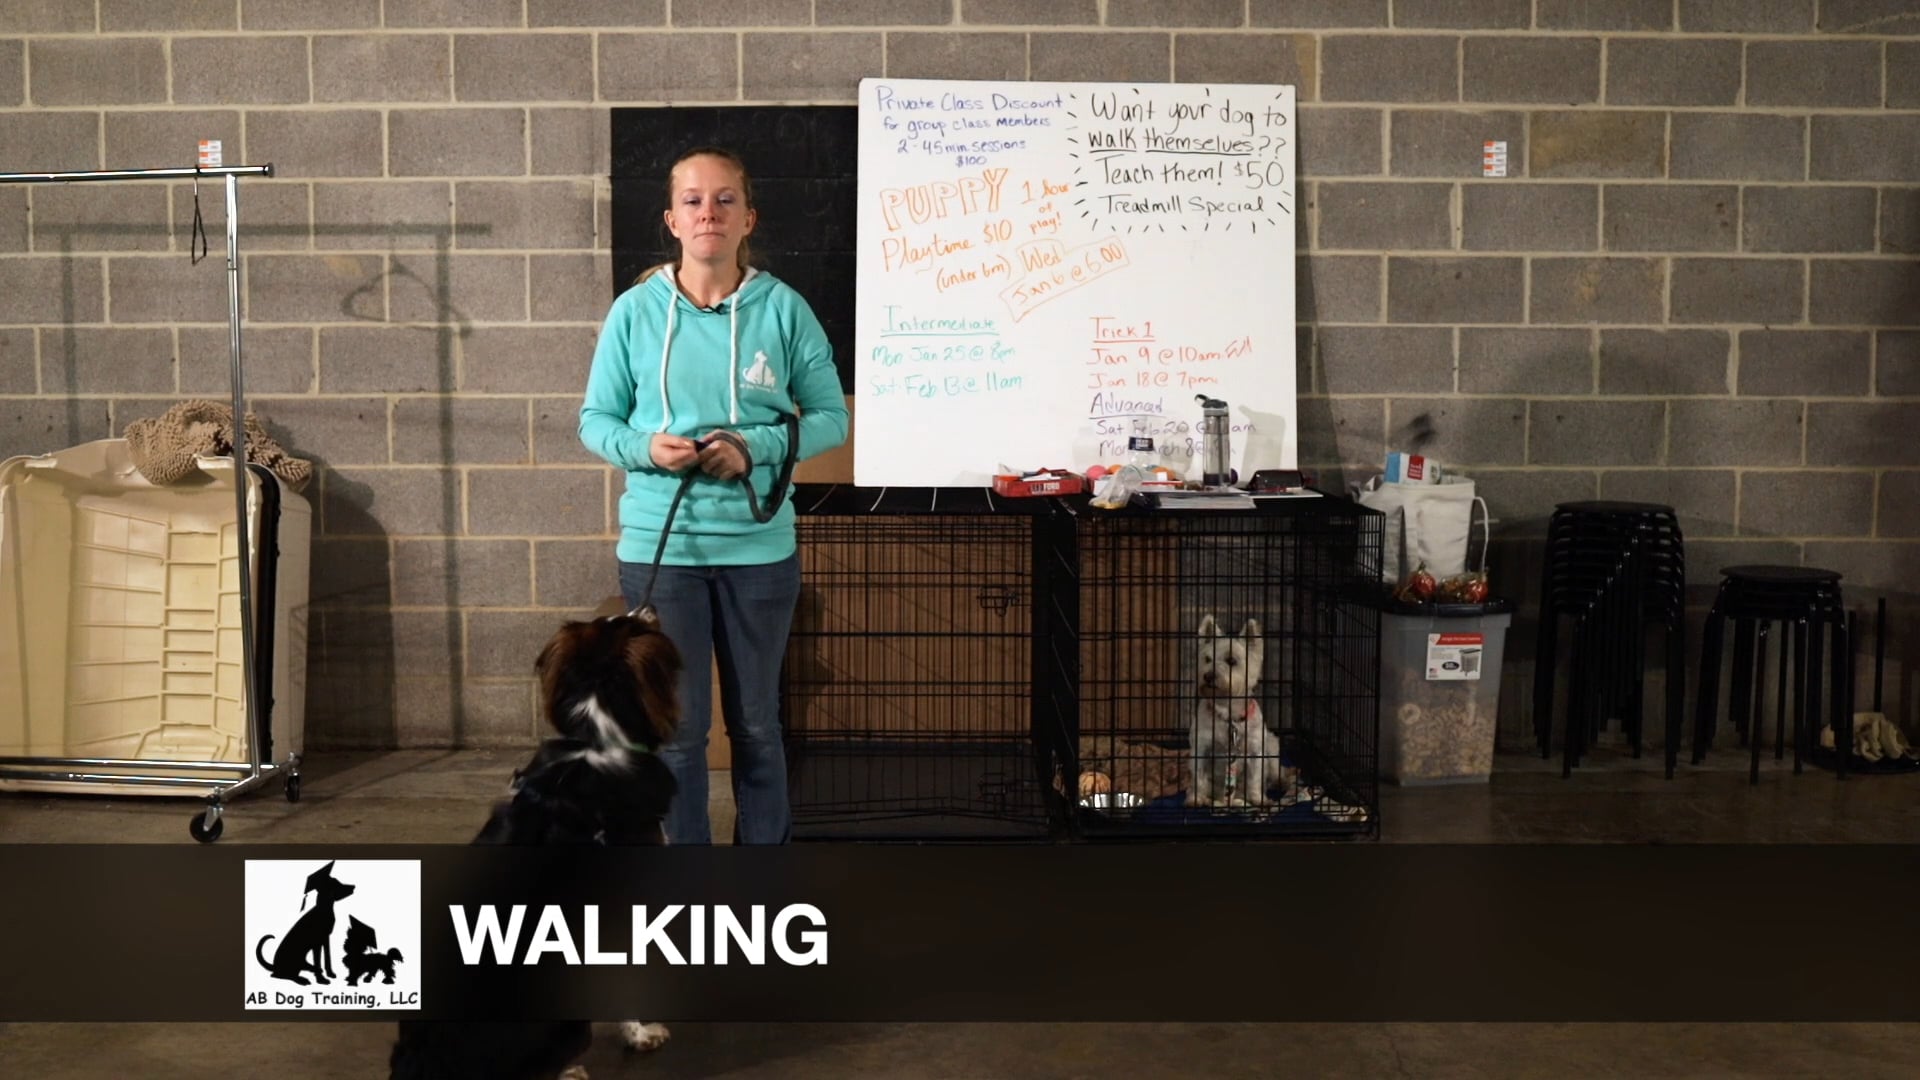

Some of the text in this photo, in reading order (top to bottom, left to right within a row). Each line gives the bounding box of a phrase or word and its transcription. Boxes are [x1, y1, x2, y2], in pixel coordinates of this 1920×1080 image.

[875, 86, 1064, 111] Private Class Discount
[1091, 92, 1287, 136] Want your dog to
[908, 120, 947, 140] group
[953, 117, 991, 131] class
[1088, 127, 1137, 149] walk
[898, 139, 908, 154] 2
[972, 139, 1026, 152] sessions
[955, 154, 987, 168] $100
[1095, 154, 1285, 190] Teach them! $50
[879, 167, 1009, 232] PUPPY
[1021, 179, 1070, 205] 1 hour
[1038, 201, 1053, 213] of
[1097, 193, 1265, 216] Treadmill Special
[882, 219, 1013, 274] Playtime $10
[1021, 246, 1062, 273] Wed
[1011, 280, 1052, 305] Jan
[1070, 264, 1087, 282] @
[880, 304, 996, 333] Intermediate
[1088, 316, 1156, 340] Trick 1
[872, 345, 903, 367] Mon
[911, 346, 938, 362] Jan
[1086, 347, 1128, 366] Jan
[1138, 346, 1151, 365] 9
[1158, 348, 1175, 366] @
[905, 374, 937, 398] Feb
[985, 371, 1023, 392] 11am
[1087, 372, 1127, 389] Jan
[1137, 371, 1151, 387] 18
[1153, 371, 1170, 388] @
[1089, 391, 1164, 415] Advanced
[1096, 419, 1125, 436] Sat
[1132, 418, 1161, 437] Feb
